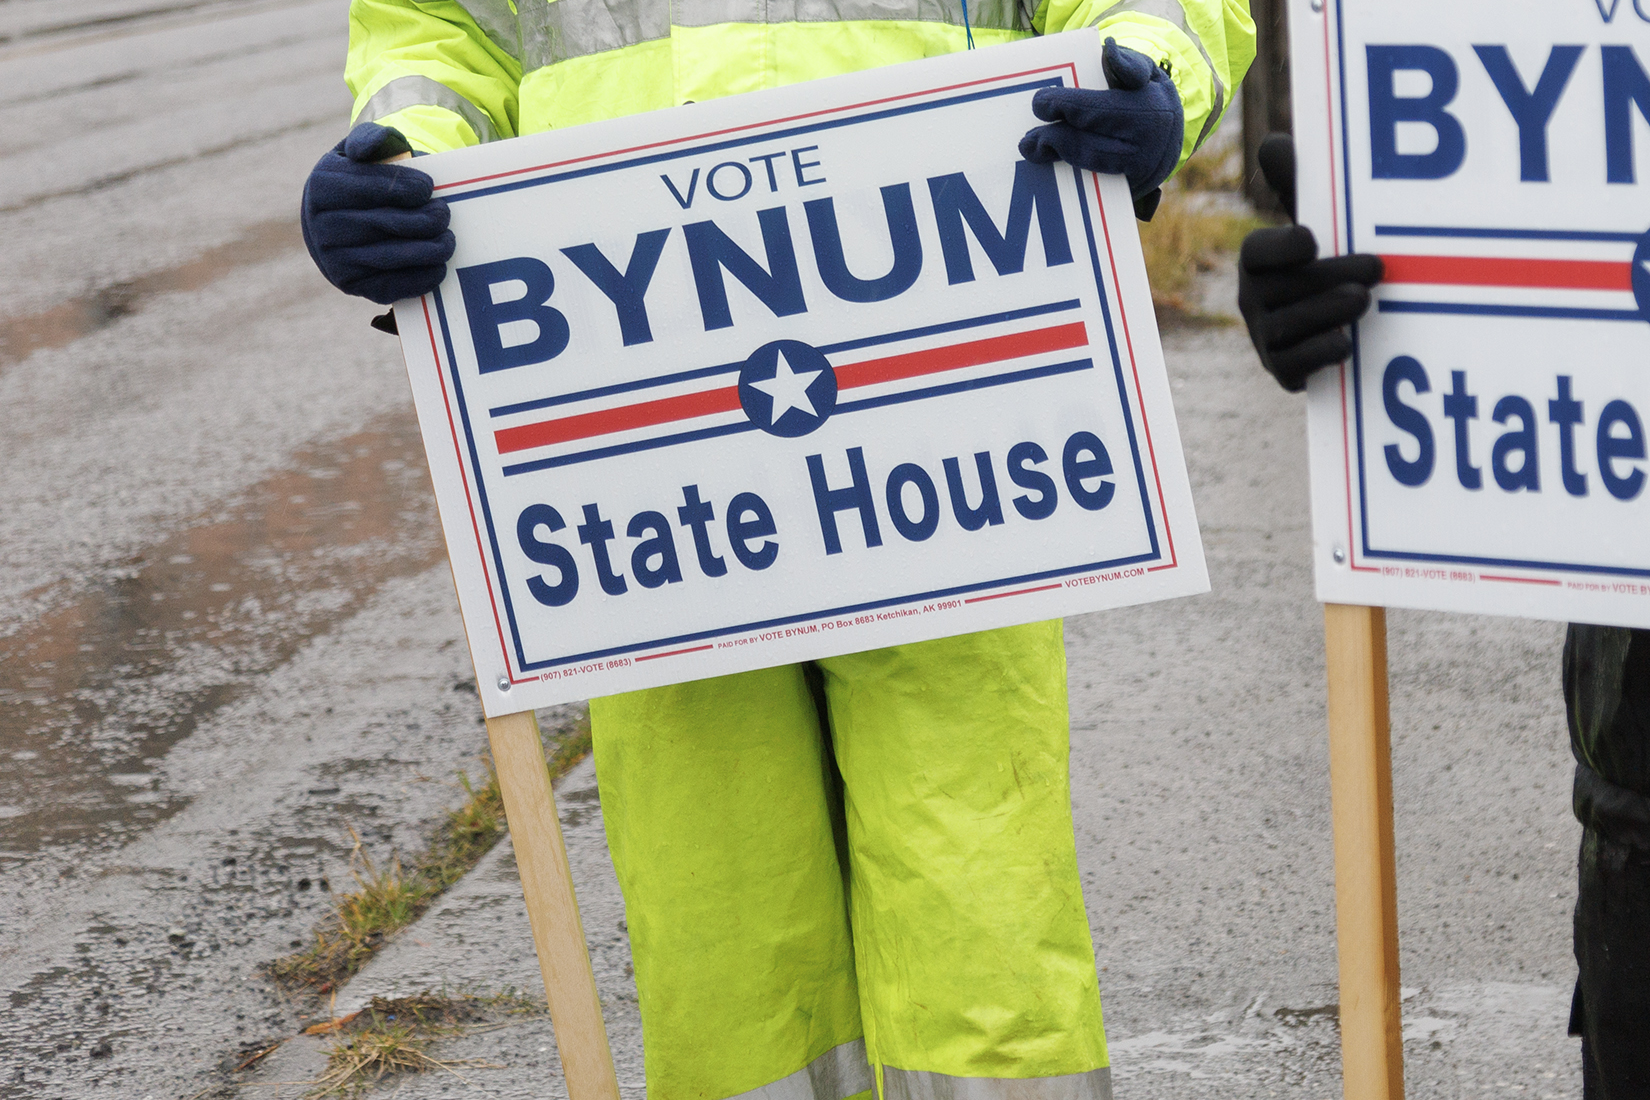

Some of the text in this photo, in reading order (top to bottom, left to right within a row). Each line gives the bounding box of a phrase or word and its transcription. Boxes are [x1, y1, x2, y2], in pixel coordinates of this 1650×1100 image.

[659, 145, 828, 211] VOTE
[456, 158, 1075, 376] BYNUM
[1380, 354, 1649, 502] State
[515, 430, 1117, 608] State House
[1065, 568, 1145, 588] VOTEBYNUM.COM
[1382, 566, 1403, 578] (907)
[1405, 568, 1448, 581] 821-VOTE
[1612, 583, 1638, 596] VOTE
[718, 599, 962, 649] PAID FOR BY VOTE BYNUM, PO Box 8683 Ketchikan, AK 99901
[540, 658, 632, 683] (907) 821-VOTE (8683)
